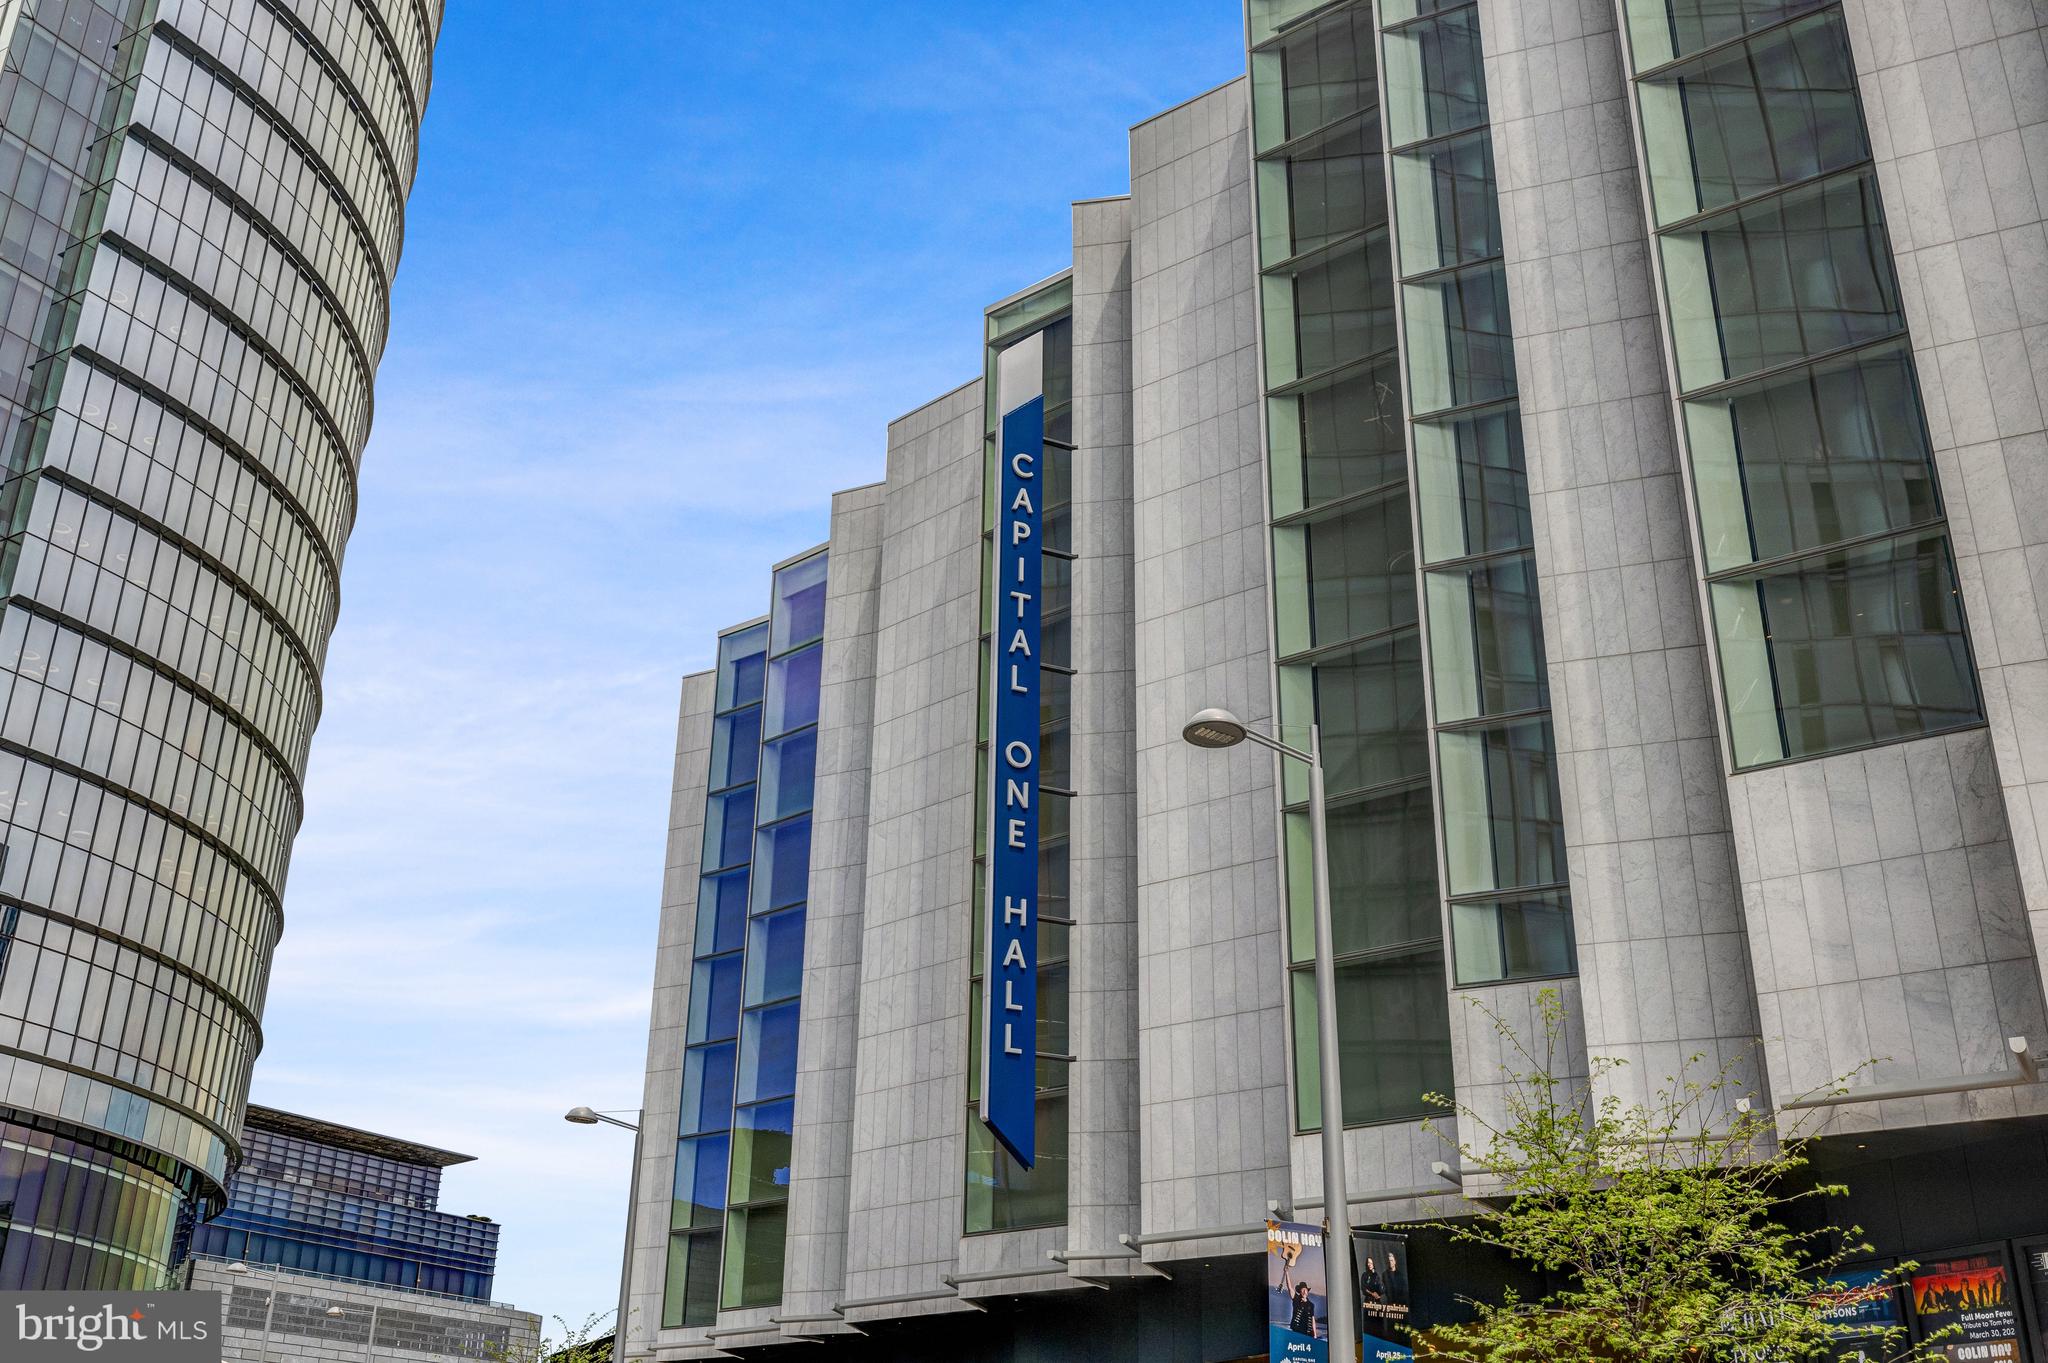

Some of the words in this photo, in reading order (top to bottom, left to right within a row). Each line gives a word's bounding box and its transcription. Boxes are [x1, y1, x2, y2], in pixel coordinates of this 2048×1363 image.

[1009, 453, 1034, 693] CAPITAL
[1005, 740, 1032, 849] ONE
[1003, 895, 1027, 1055] HALL
[1267, 1229, 1299, 1245] COLIN
[1301, 1232, 1322, 1247] HAY
[1961, 1312, 1974, 1322] Full
[1974, 1312, 1995, 1321] Moon
[1962, 1322, 1982, 1330] Tribute
[1990, 1319, 2003, 1327] Tom
[1970, 1330, 1990, 1339] March
[1990, 1329, 2002, 1338] 30,
[1287, 1342, 1306, 1353] April
[1305, 1343, 1312, 1352] 4
[1376, 1349, 1392, 1360] April
[1392, 1351, 1402, 1360] 25
[1957, 1345, 1989, 1360] COLIN
[1990, 1342, 2012, 1358] HAY
